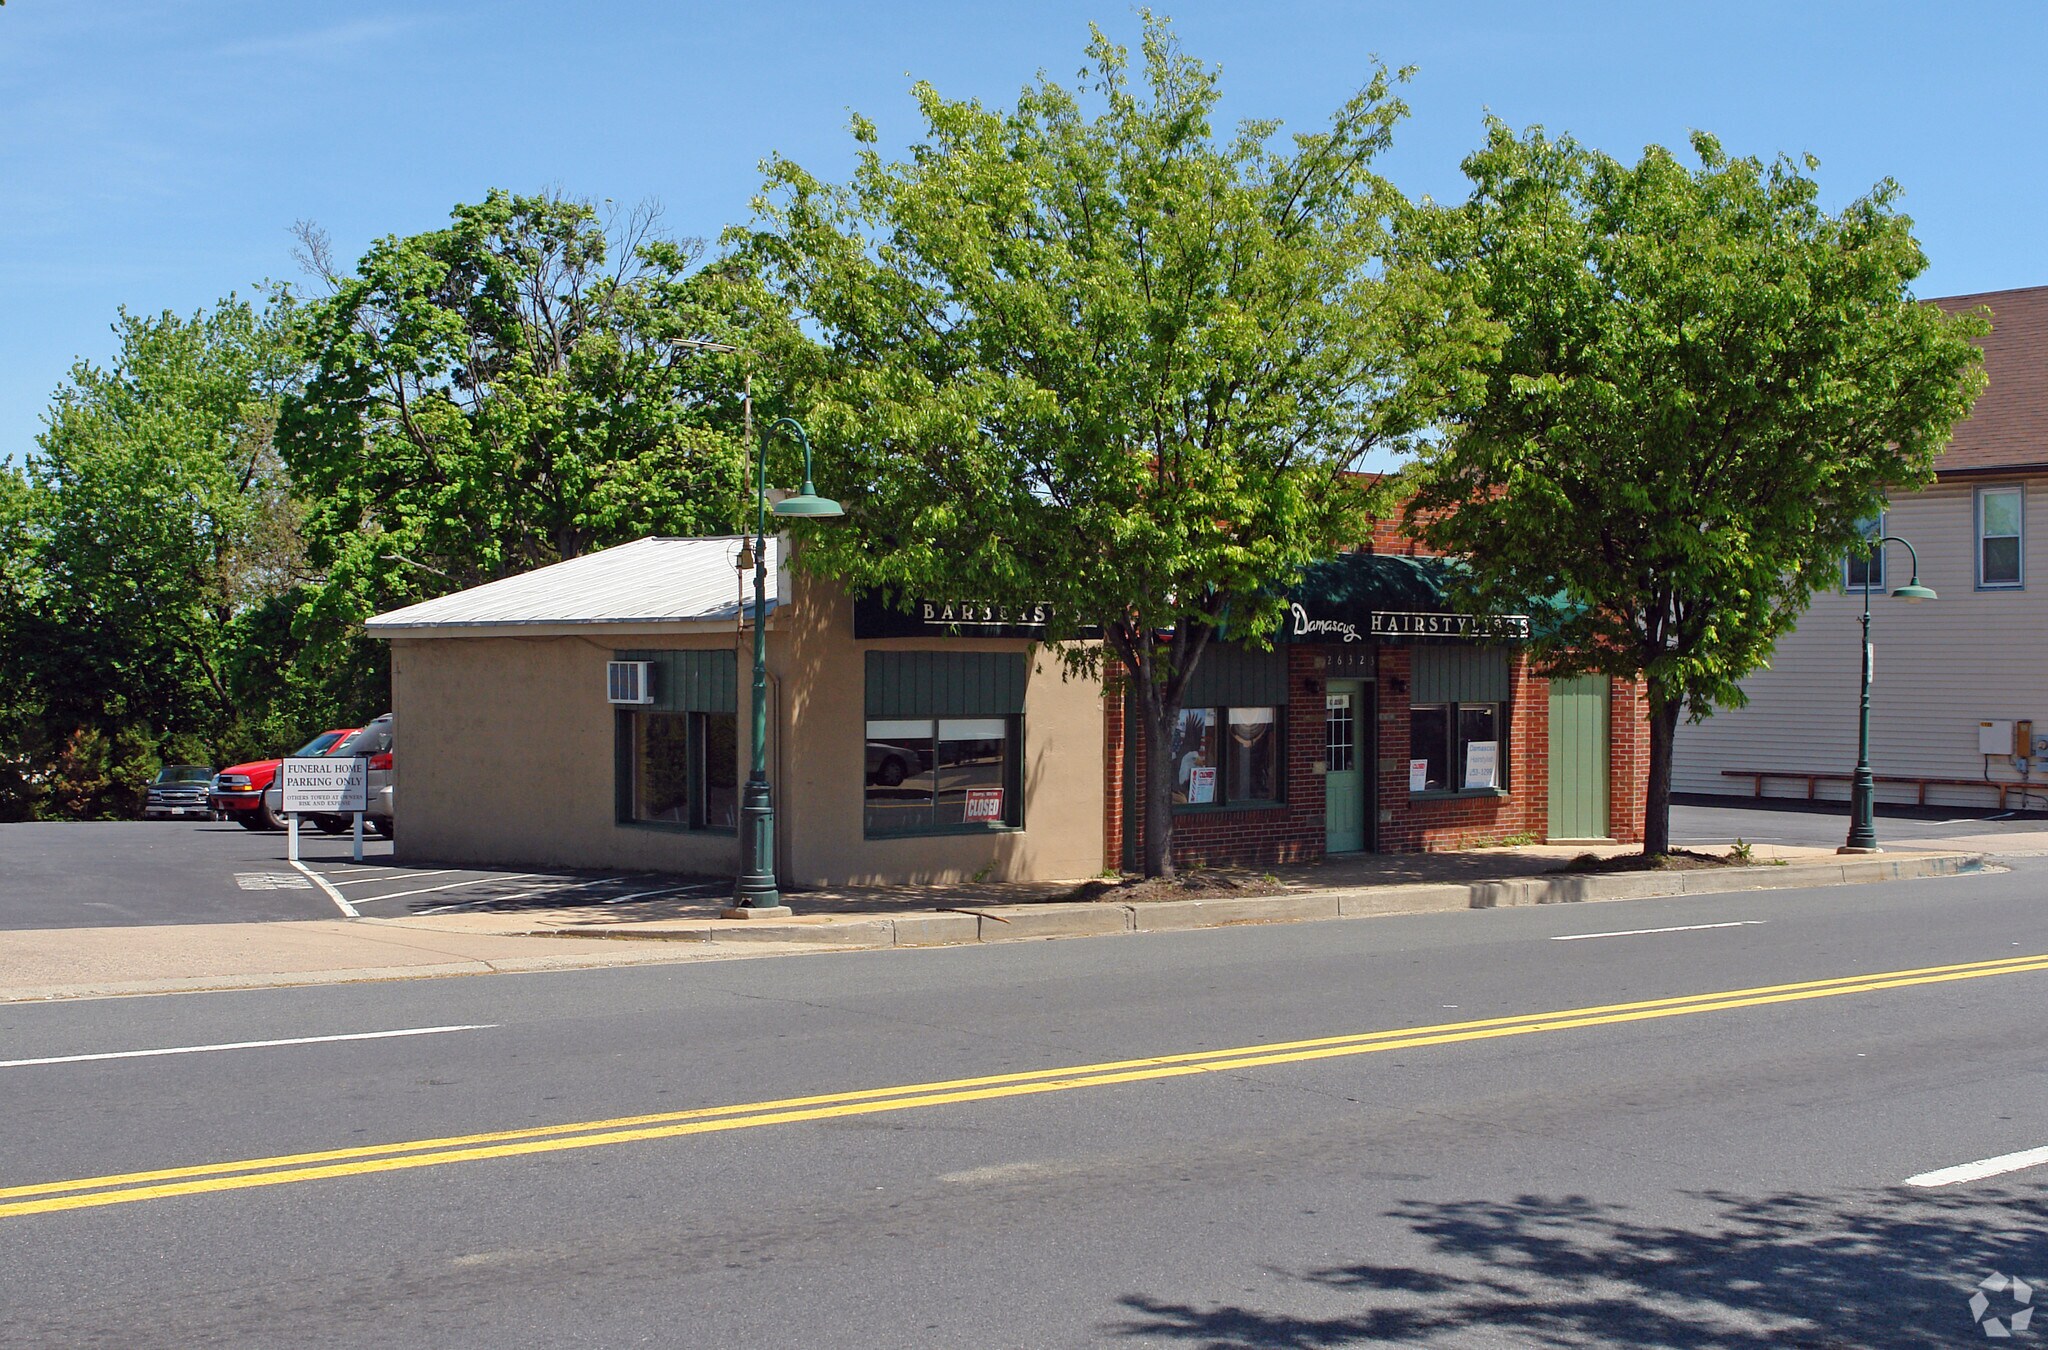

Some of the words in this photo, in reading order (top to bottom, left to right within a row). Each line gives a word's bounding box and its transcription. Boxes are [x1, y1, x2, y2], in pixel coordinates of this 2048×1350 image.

[1291, 602, 1362, 642] Damascus
[288, 764, 332, 773] FUNERAL
[335, 764, 362, 773] HOME
[287, 777, 332, 786] PARKING
[336, 777, 362, 786] ONLY
[968, 798, 999, 816] CLOSED
